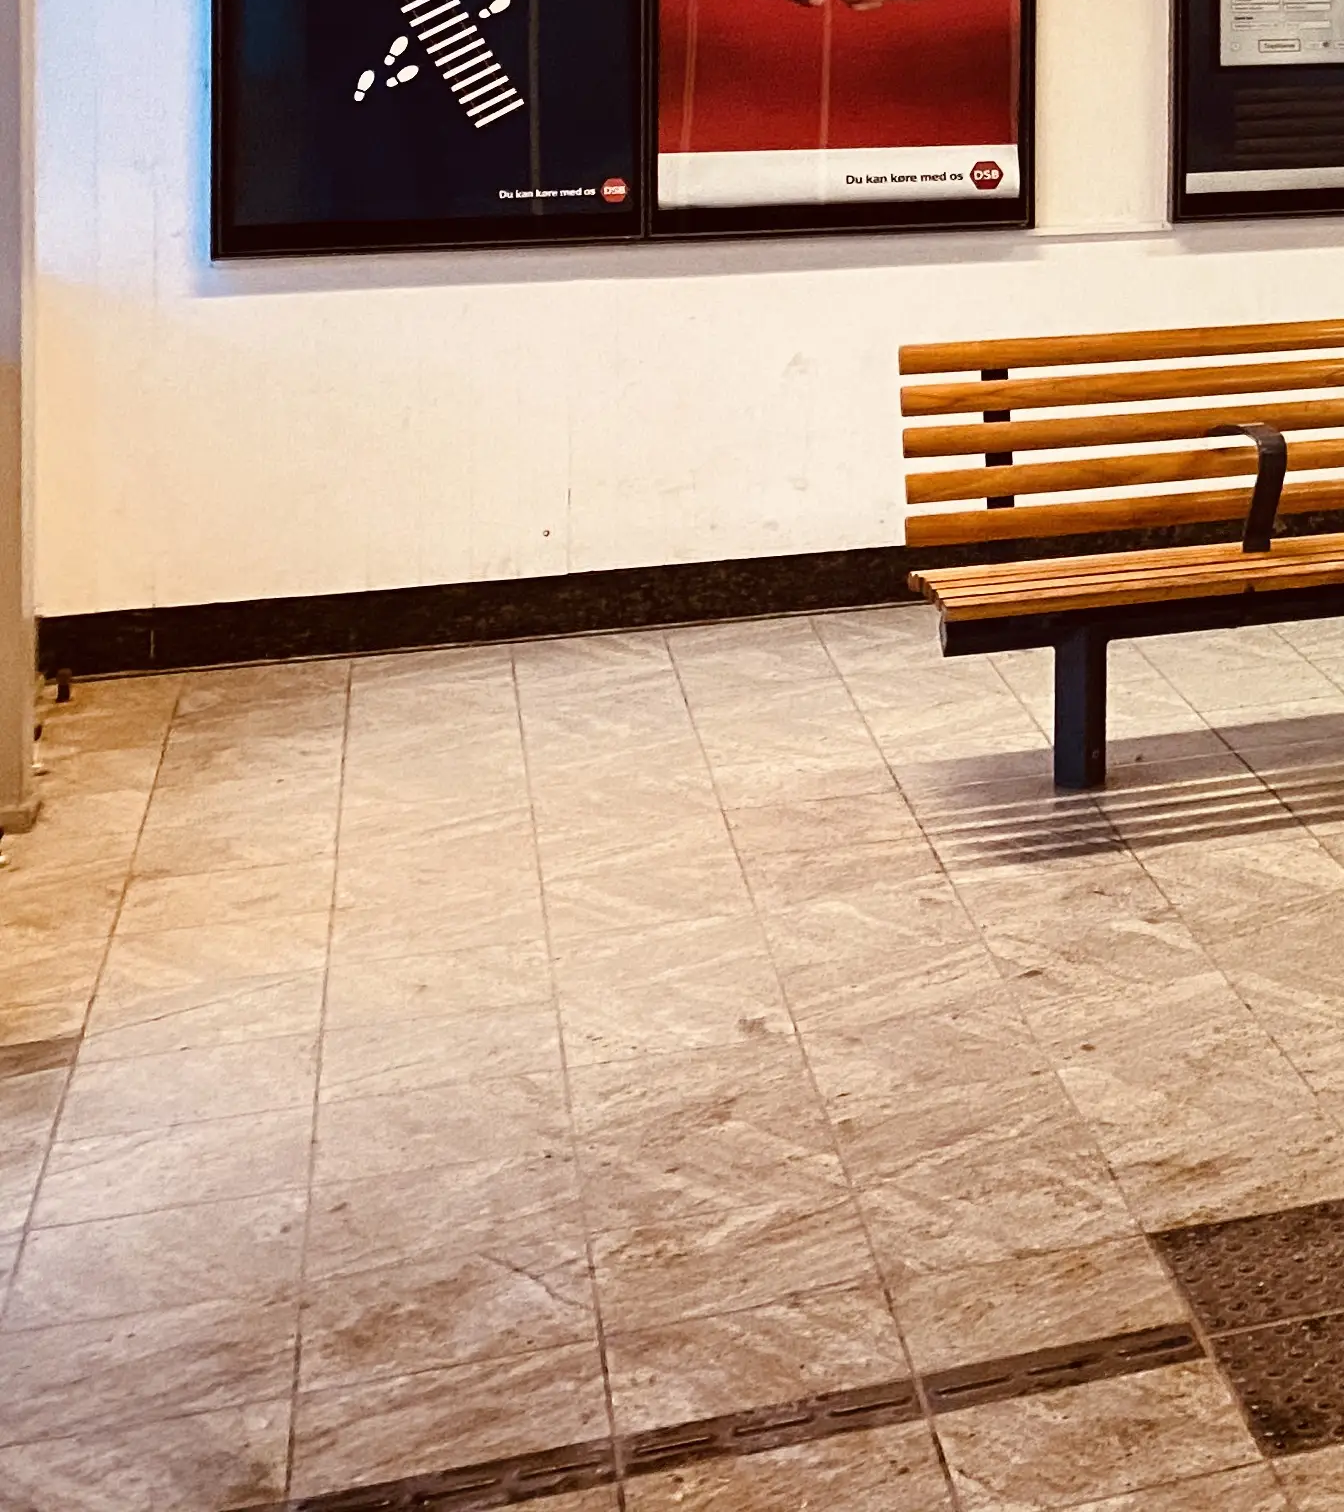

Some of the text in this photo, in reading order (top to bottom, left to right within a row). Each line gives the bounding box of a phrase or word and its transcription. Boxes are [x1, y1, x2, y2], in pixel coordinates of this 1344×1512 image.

[846, 172, 964, 185] Du kan køre med os
[973, 169, 1000, 181] DSB
[499, 190, 514, 199] Du
[516, 189, 533, 198] kan
[560, 188, 583, 197] med
[584, 188, 596, 196] os
